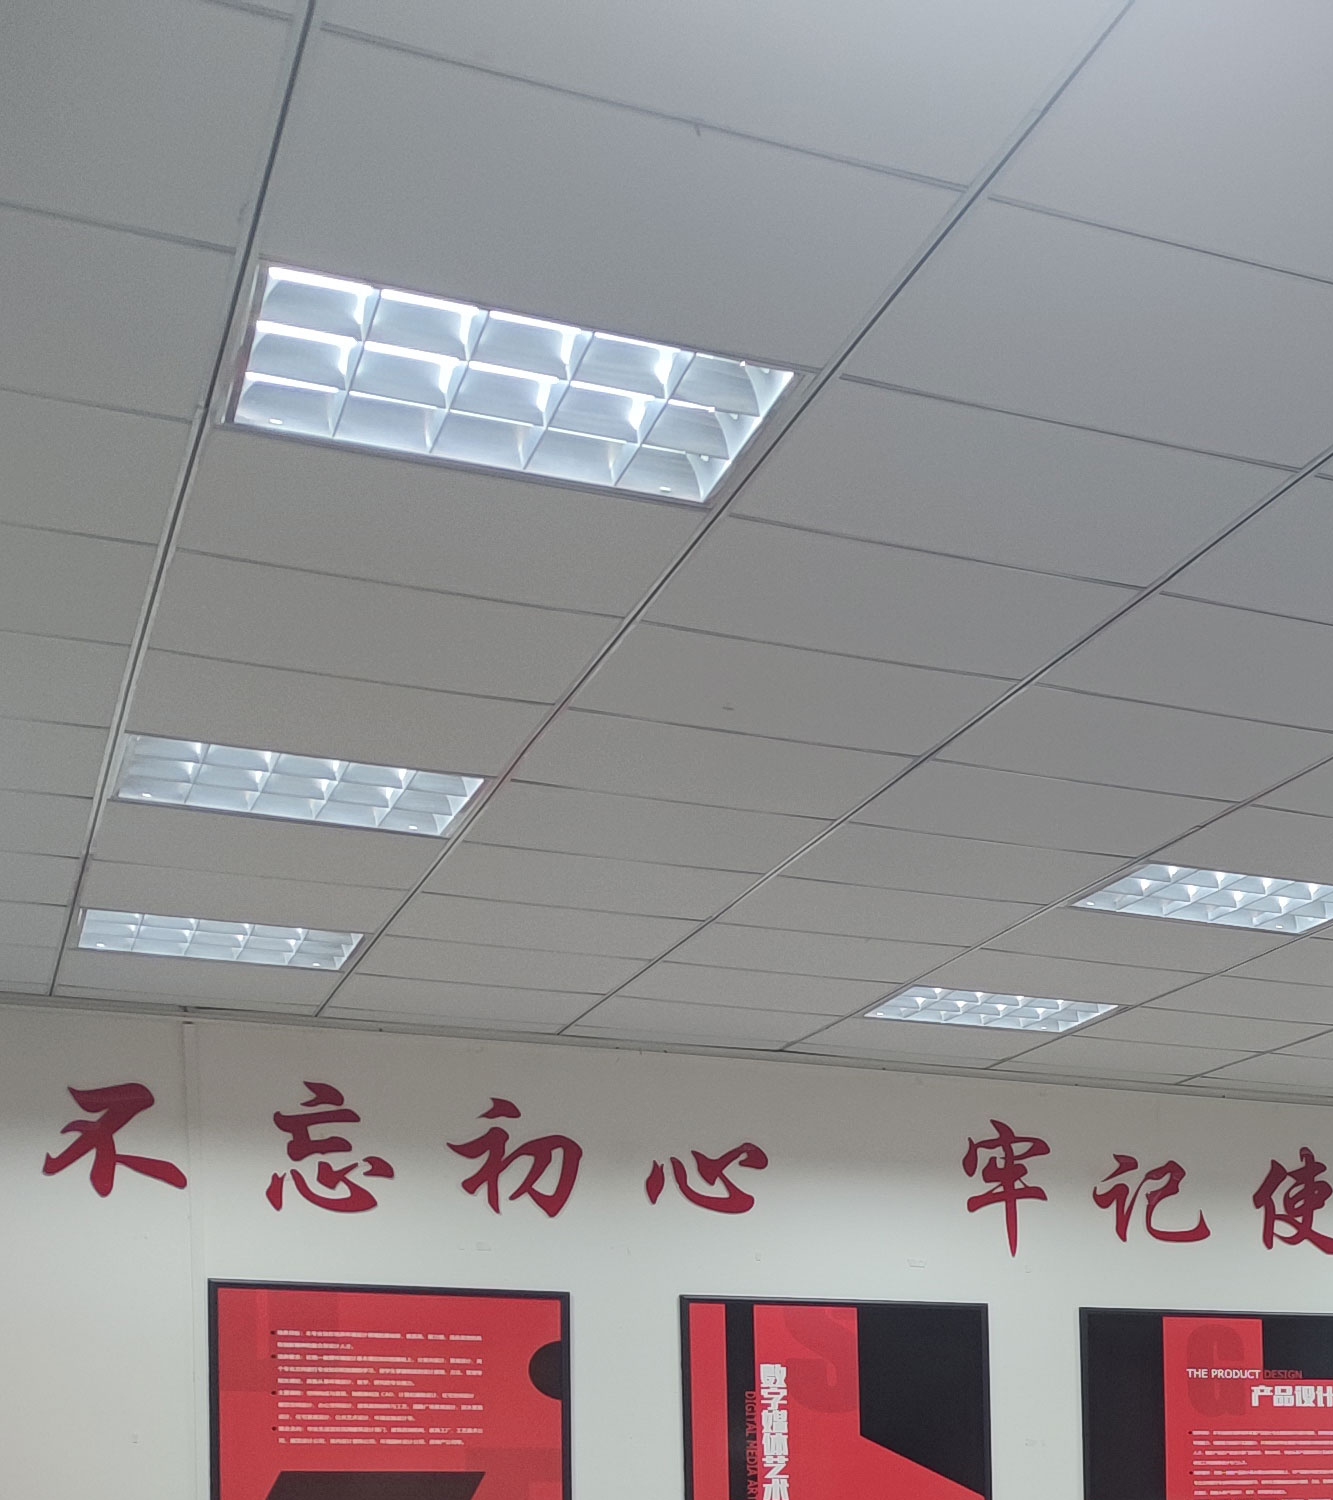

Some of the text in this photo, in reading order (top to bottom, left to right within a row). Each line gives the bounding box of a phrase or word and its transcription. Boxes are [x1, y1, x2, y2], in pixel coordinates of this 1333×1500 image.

[42, 1080, 769, 1218] 不忘初心
[1186, 1368, 1303, 1380] THE PRODUCT DESIGN
[745, 1391, 757, 1436] DIGITAL
[745, 1439, 758, 1476] MEDIA
